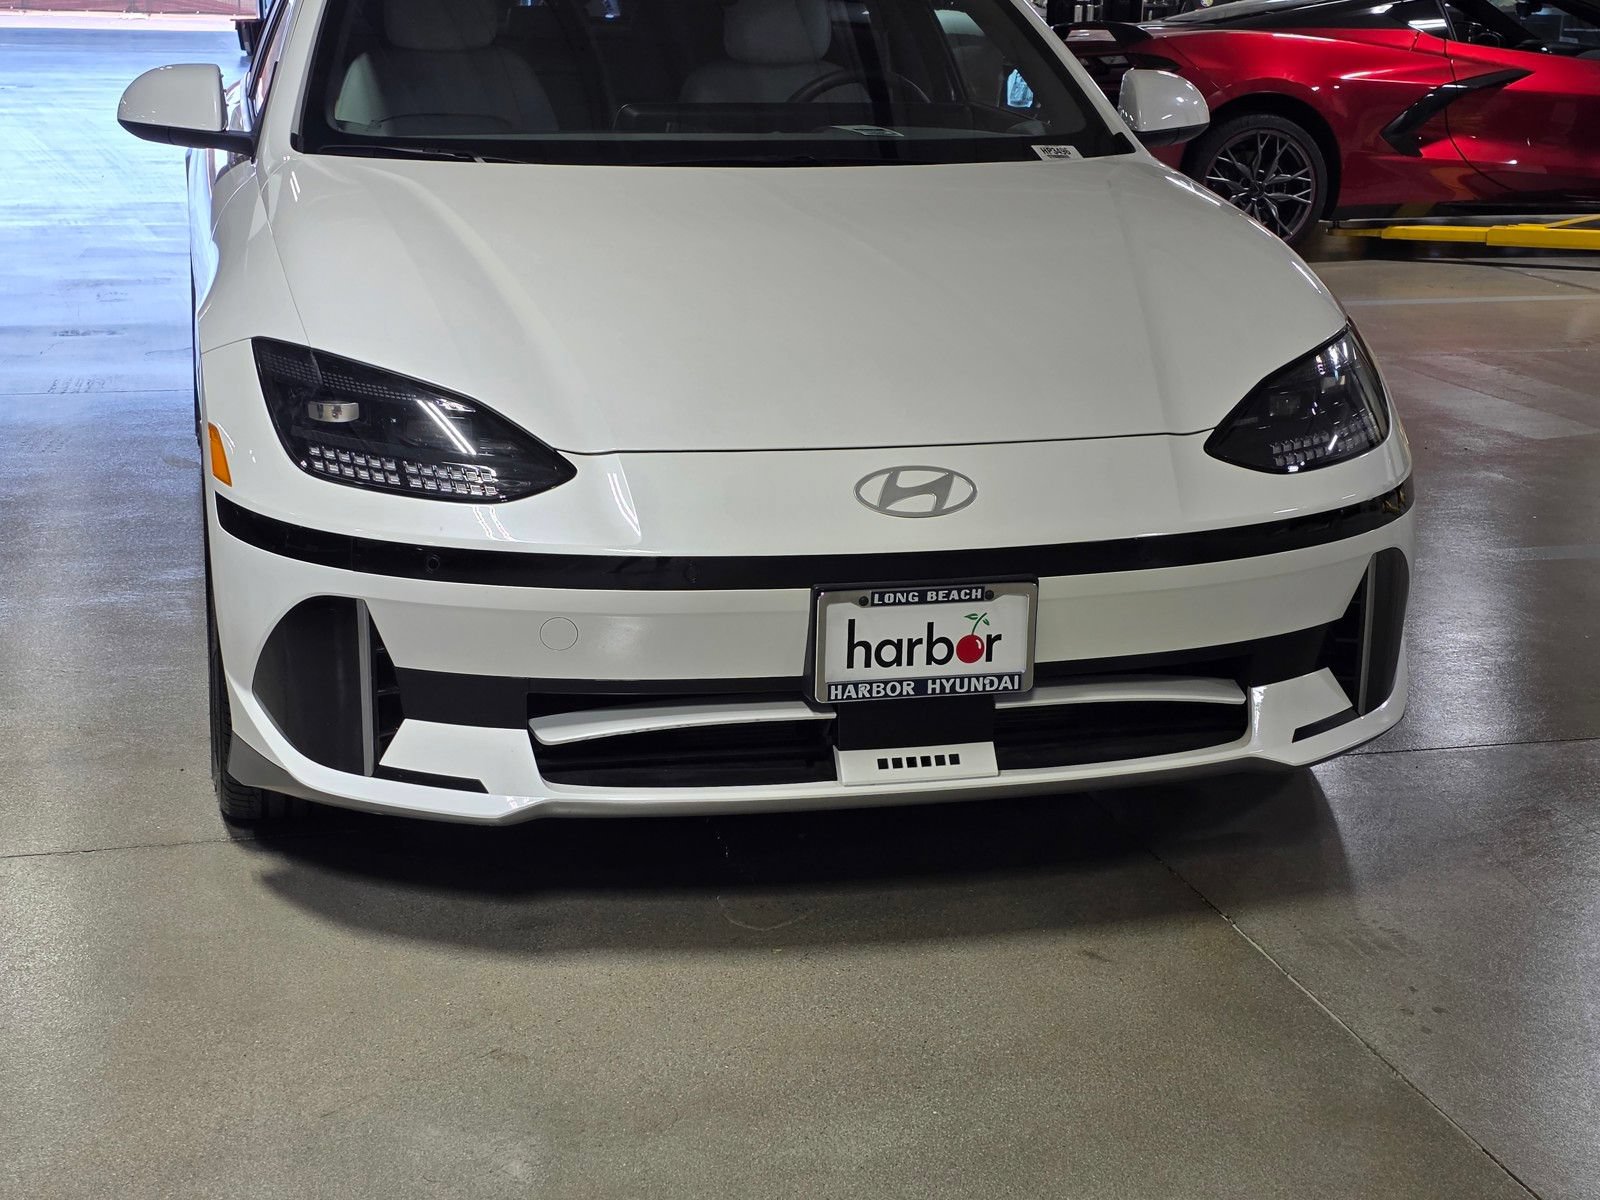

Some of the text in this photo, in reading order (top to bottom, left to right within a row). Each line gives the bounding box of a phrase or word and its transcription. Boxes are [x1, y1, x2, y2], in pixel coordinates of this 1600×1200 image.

[873, 588, 982, 604] LONG BEACH
[846, 617, 1002, 669] harbor
[830, 675, 1019, 700] HARBOR HYUNDAI
